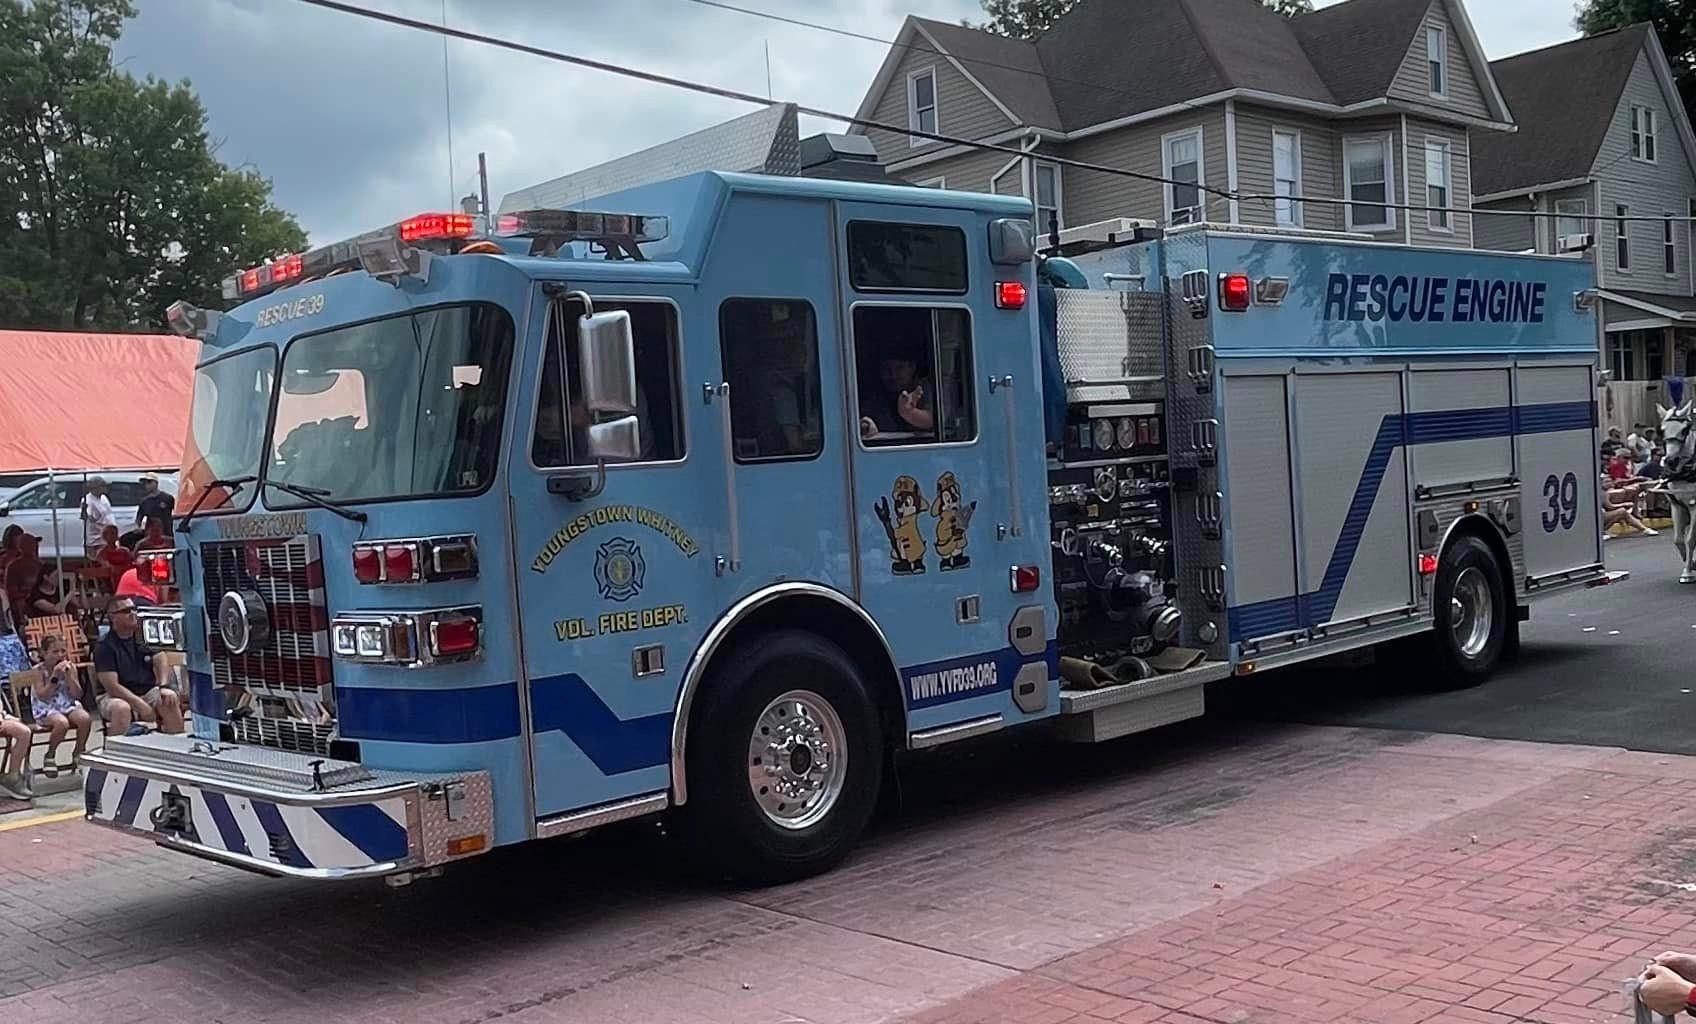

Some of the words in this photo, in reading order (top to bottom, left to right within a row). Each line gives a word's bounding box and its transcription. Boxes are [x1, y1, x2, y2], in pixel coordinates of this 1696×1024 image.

[256, 298, 306, 328] RESCUE
[306, 294, 325, 314] 39
[1323, 273, 1449, 322] RESCUE
[1452, 279, 1547, 323] ENGINE
[1541, 471, 1578, 533] 39
[531, 506, 633, 574] YOUNGSTOWN
[637, 508, 700, 558] WHITNEY
[554, 618, 595, 641] VOL.
[599, 611, 638, 635] FIRE
[642, 604, 689, 628] DEPT.
[910, 661, 998, 700] WWW.YVFD39.ORG
